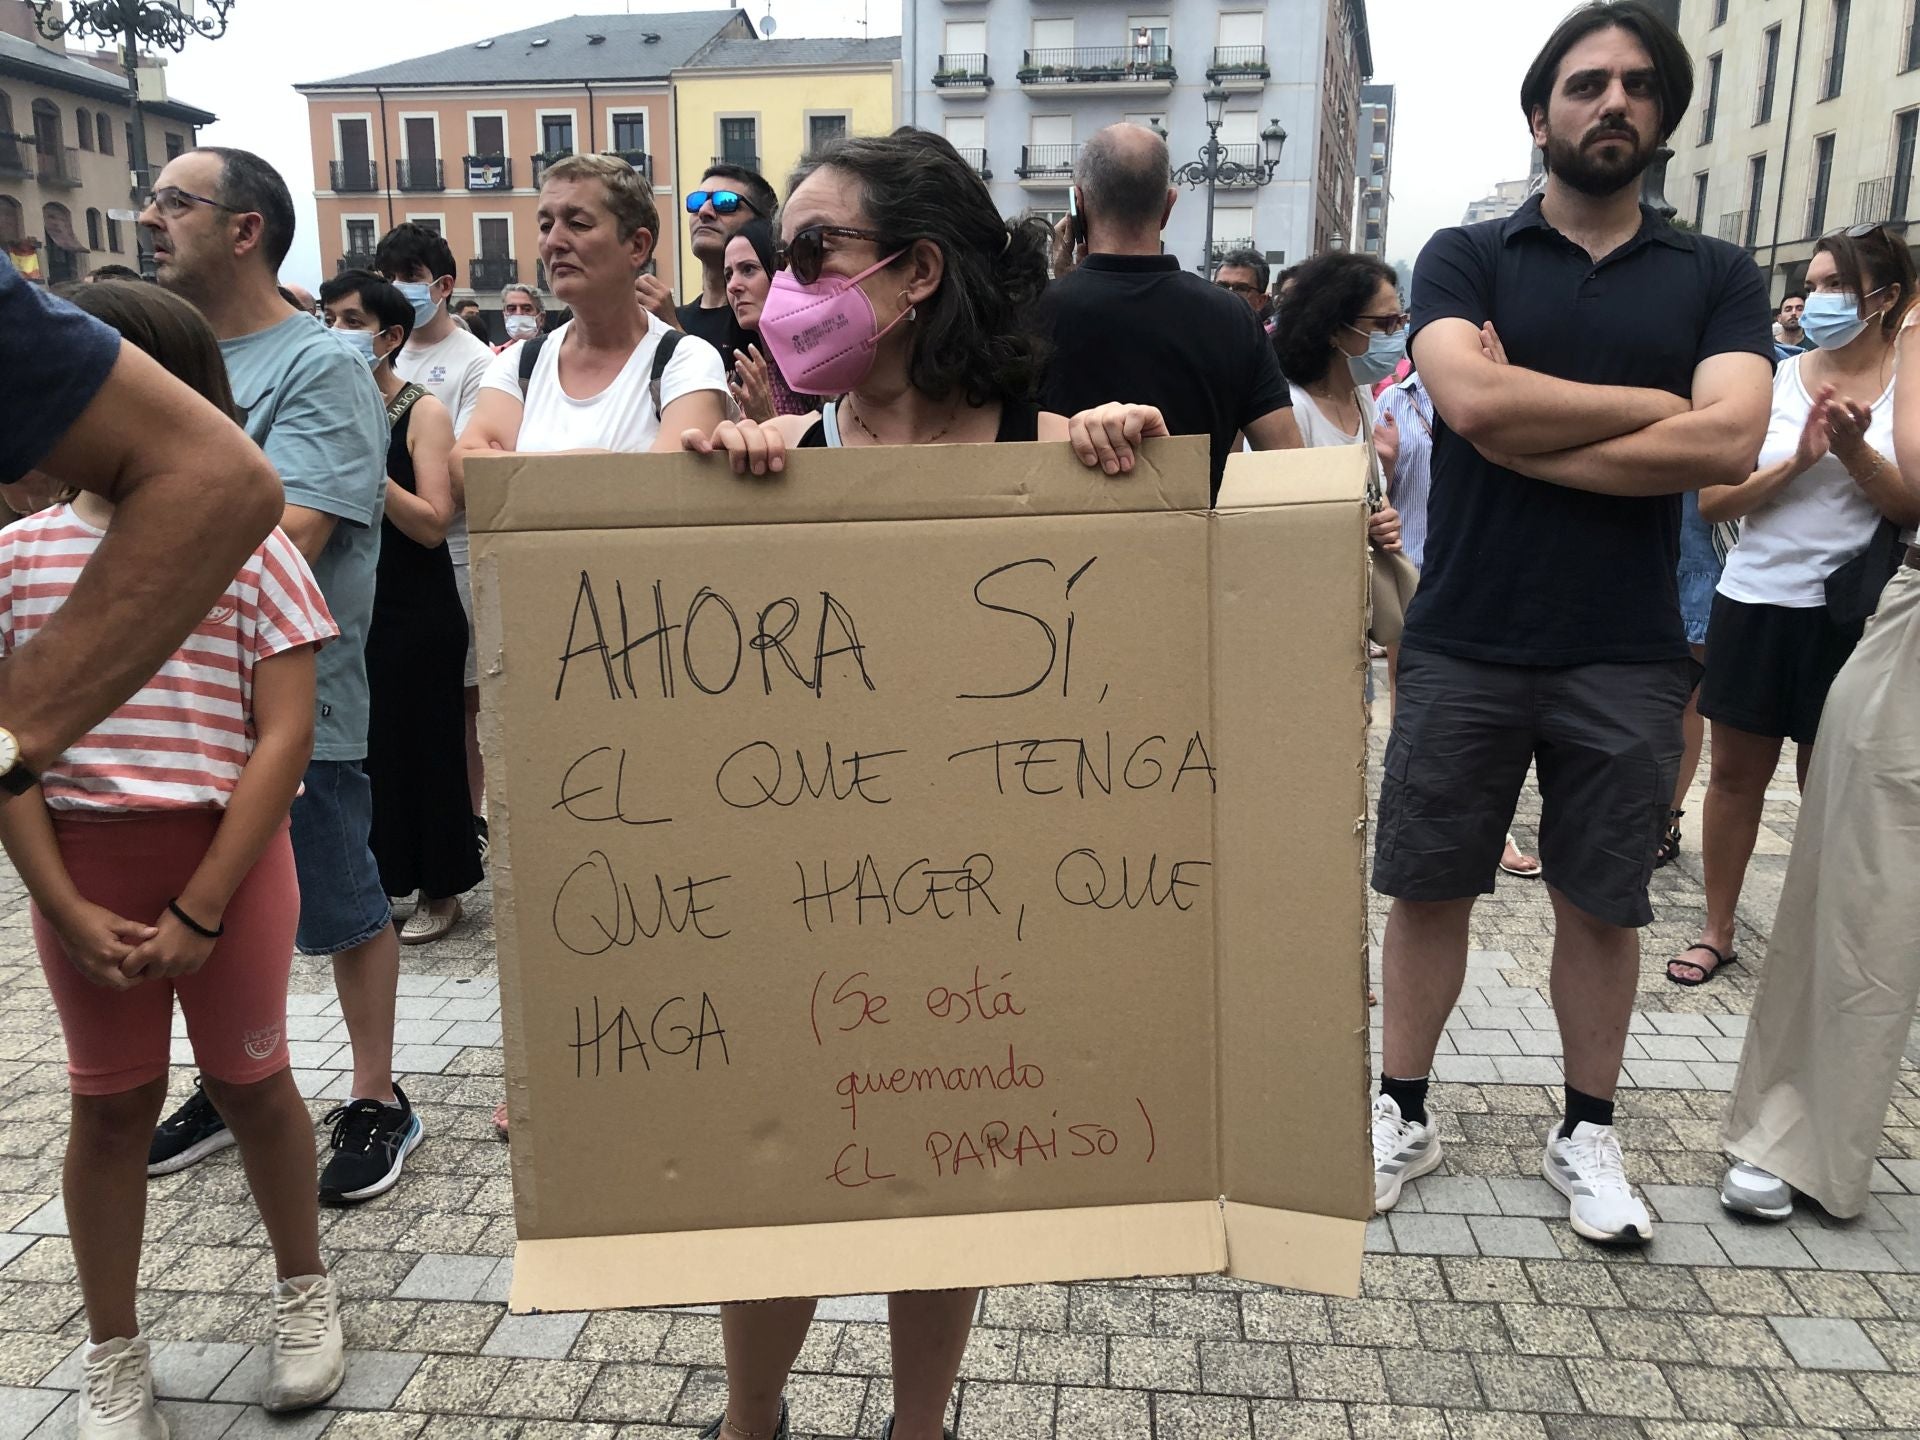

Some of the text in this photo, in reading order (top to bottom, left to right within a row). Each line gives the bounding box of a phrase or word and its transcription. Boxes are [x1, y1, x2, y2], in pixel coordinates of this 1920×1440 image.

[388, 389, 420, 421] LOEWE
[555, 570, 876, 701] AHORA
[552, 730, 1217, 825] EL QUE TENGA
[553, 850, 731, 956] QUE
[1056, 848, 1212, 911] QUE
[568, 965, 1026, 1078] HAGA (Se está
[836, 1043, 1045, 1130] quemando
[826, 1144, 896, 1188] EL
